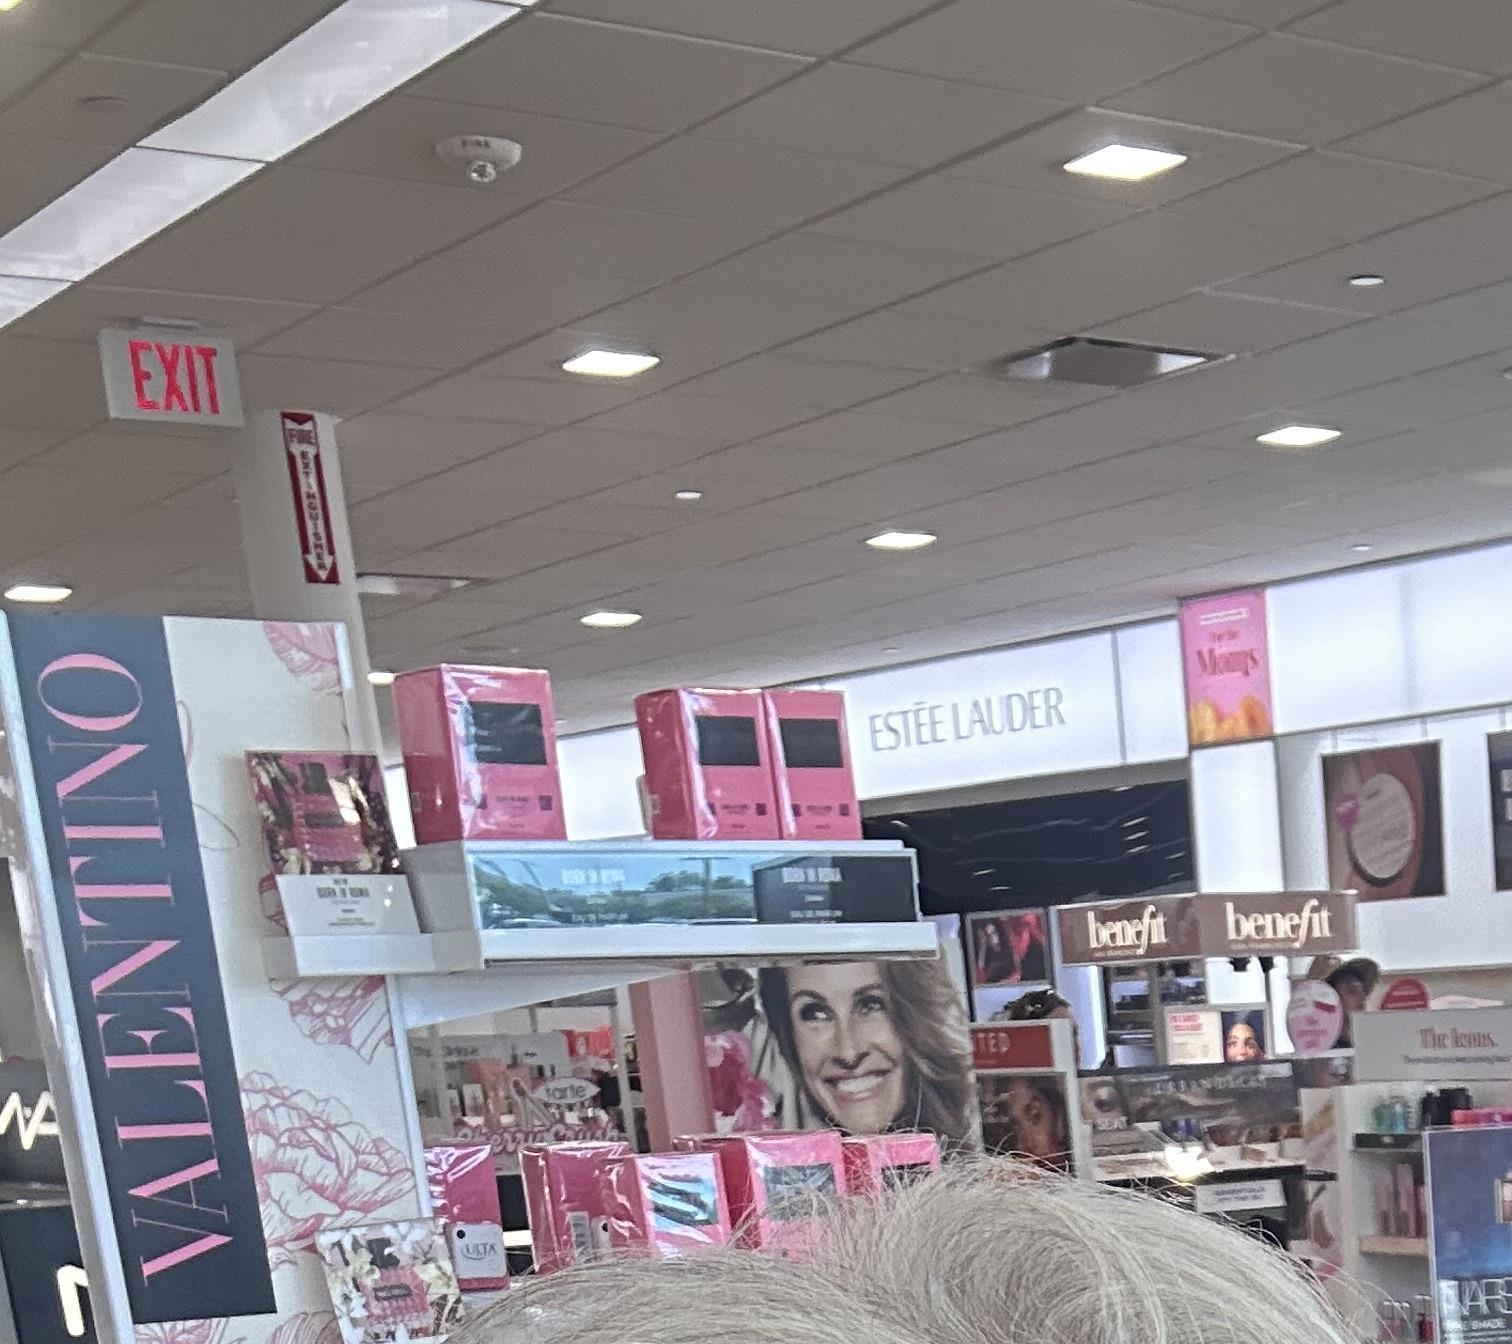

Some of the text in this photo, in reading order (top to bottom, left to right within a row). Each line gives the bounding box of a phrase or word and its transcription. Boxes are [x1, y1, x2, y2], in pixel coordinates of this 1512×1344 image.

[129, 340, 220, 415] EXIT
[951, 687, 1066, 740] LAUDER
[1086, 903, 1169, 956] benefit
[1225, 898, 1333, 949] benefit
[37, 652, 234, 1288] VALENTINO
